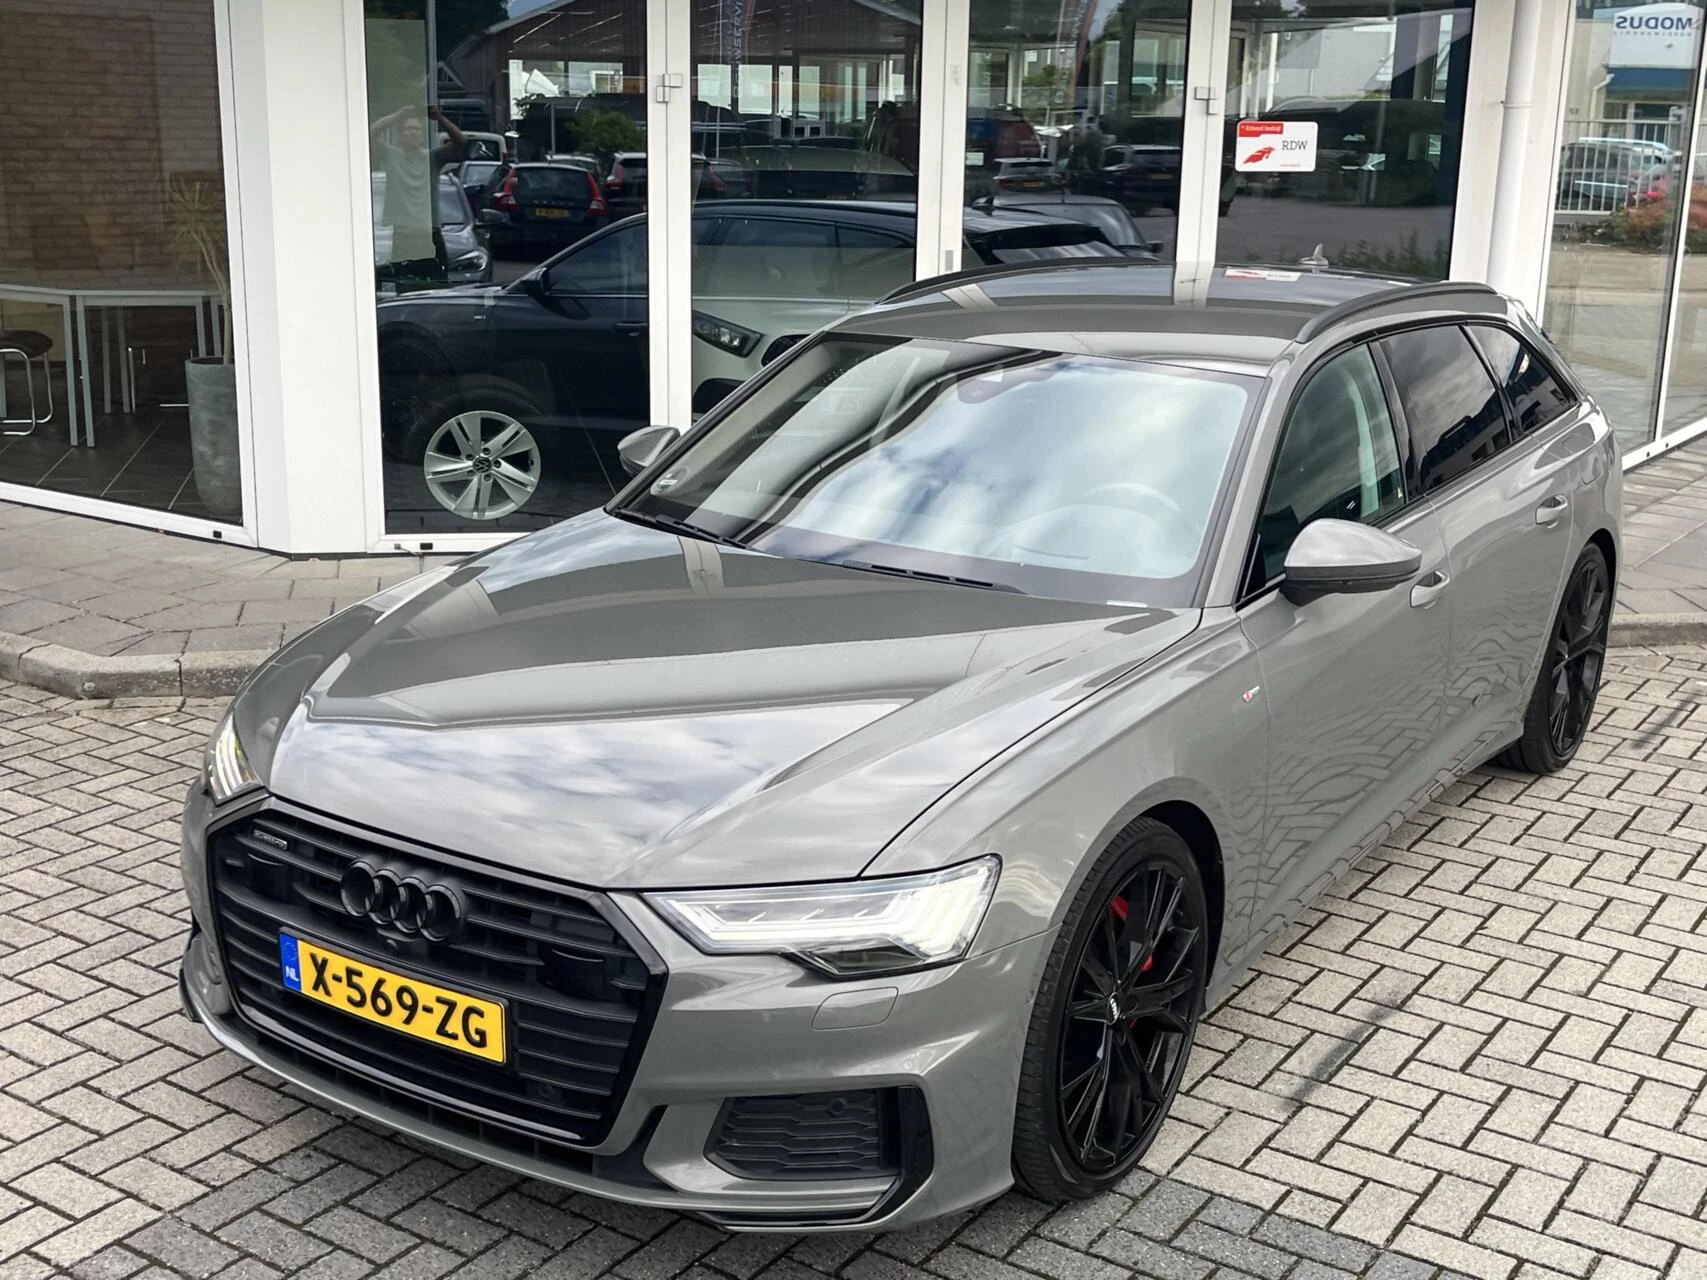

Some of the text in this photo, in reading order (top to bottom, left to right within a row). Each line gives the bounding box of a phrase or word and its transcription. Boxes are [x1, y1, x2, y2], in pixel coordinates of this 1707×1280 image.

[1281, 140, 1308, 151] RDW
[285, 965, 300, 981] NL
[309, 952, 488, 1049] X-569-ZG
